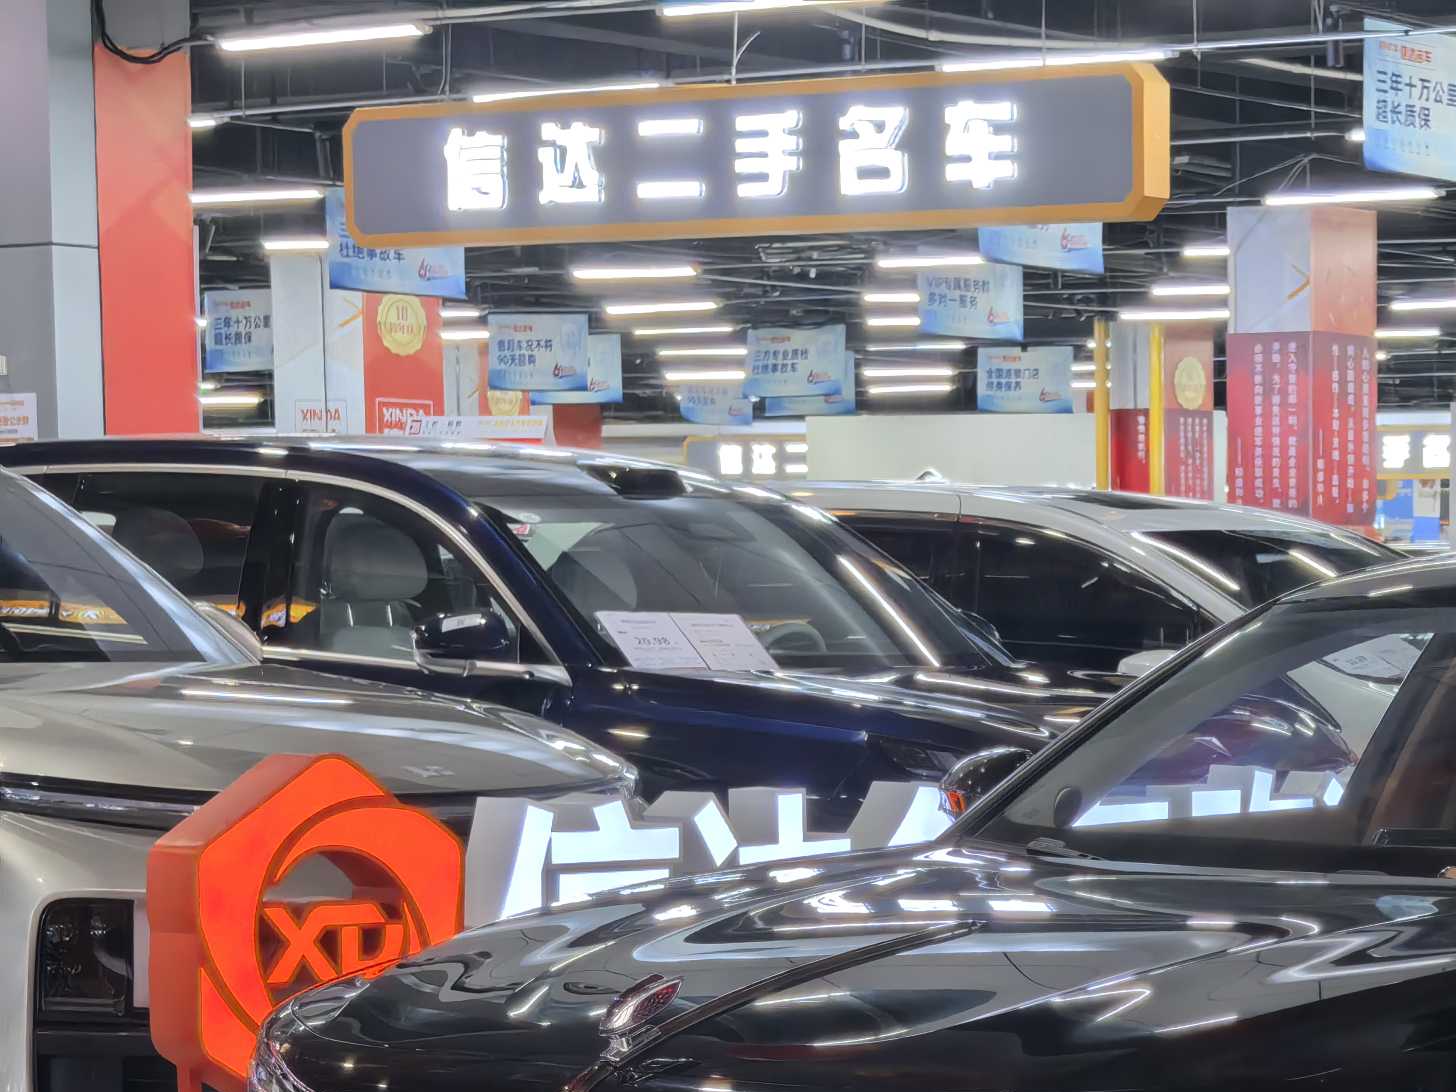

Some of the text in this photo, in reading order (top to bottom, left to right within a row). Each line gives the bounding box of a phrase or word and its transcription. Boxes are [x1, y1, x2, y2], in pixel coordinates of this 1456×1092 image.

[1376, 99, 1432, 130] 超长质保
[444, 101, 1019, 210] 信达二手名车
[213, 315, 271, 331] 三年十万公里
